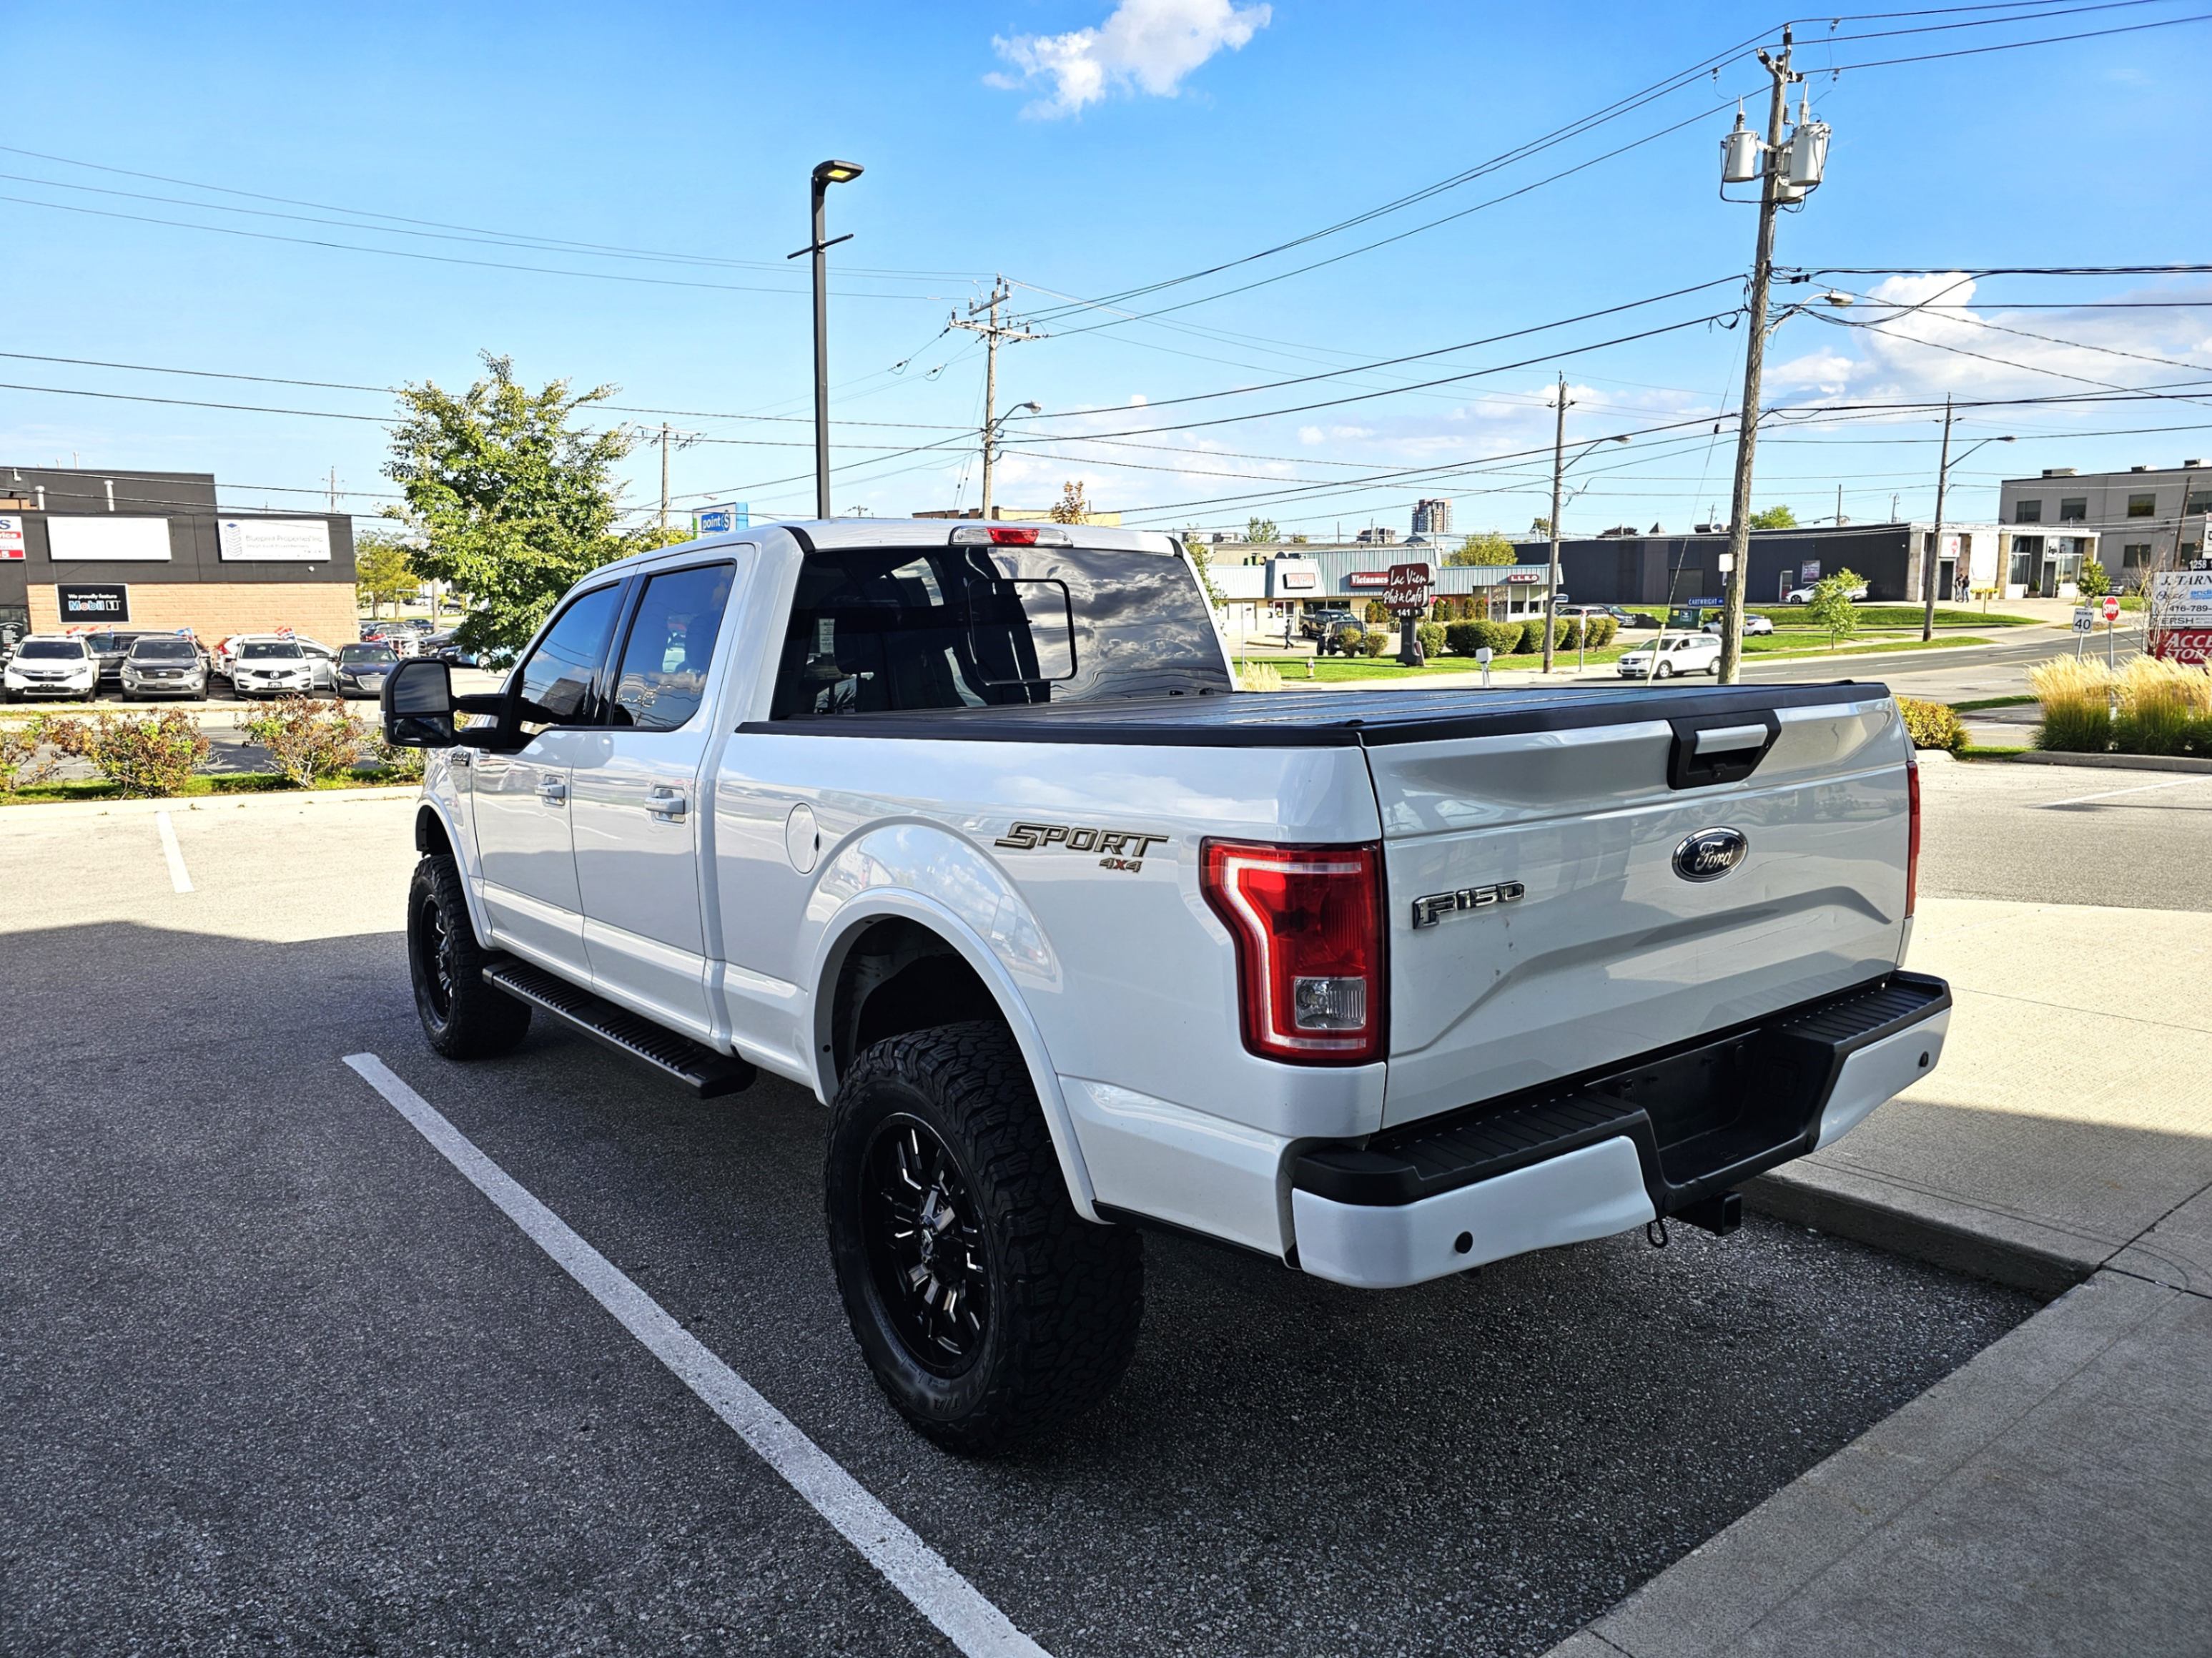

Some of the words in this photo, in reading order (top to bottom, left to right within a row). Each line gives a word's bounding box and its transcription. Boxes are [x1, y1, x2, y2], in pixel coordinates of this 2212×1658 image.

[703, 515, 721, 528] point
[2189, 560, 2207, 569] 1258
[1391, 570, 1405, 586] Lac
[1406, 568, 1426, 585] Vien
[1399, 593, 1406, 603] &
[1406, 587, 1423, 606] Café
[68, 600, 105, 611] Mobil
[2104, 604, 2119, 614] STOP
[2075, 618, 2091, 630] 40
[994, 821, 1170, 857] SPORT
[1694, 840, 1734, 871] Ford
[1412, 880, 1526, 929] F150
